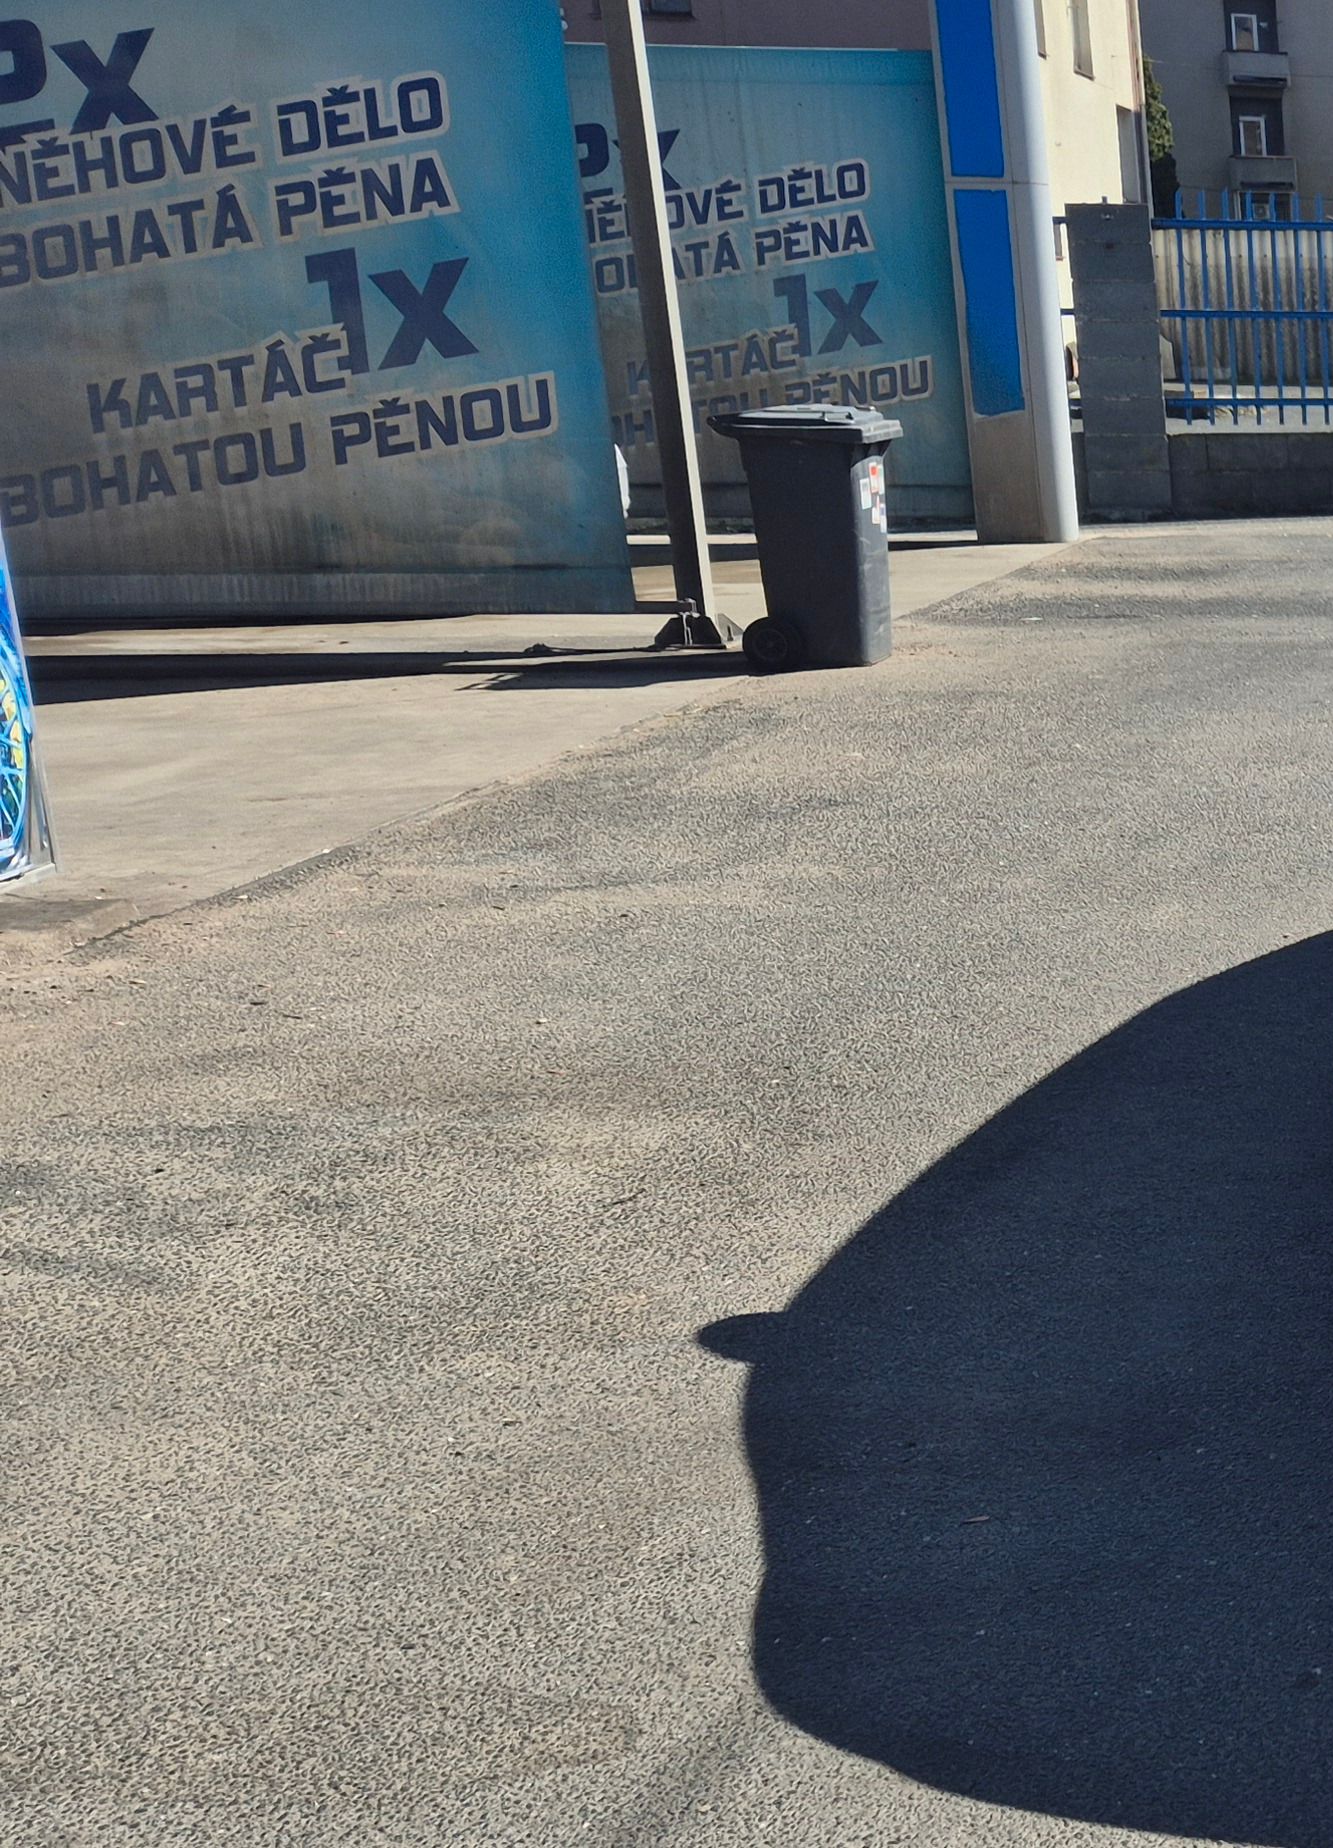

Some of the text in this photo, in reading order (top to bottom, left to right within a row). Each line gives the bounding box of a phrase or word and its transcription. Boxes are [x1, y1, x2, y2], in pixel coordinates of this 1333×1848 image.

[277, 77, 443, 157] DĚLO
[0, 157, 452, 288] BOHATÁ PĚNA
[758, 162, 867, 213] DĚLO
[755, 215, 869, 267] PĚNA
[305, 247, 480, 375] 1x
[773, 274, 883, 357] 1x
[87, 333, 347, 434] KARTÁČ
[627, 330, 796, 396] KRTÁČ
[0, 423, 307, 528] BOHATOU
[331, 379, 552, 466] PĚNOU
